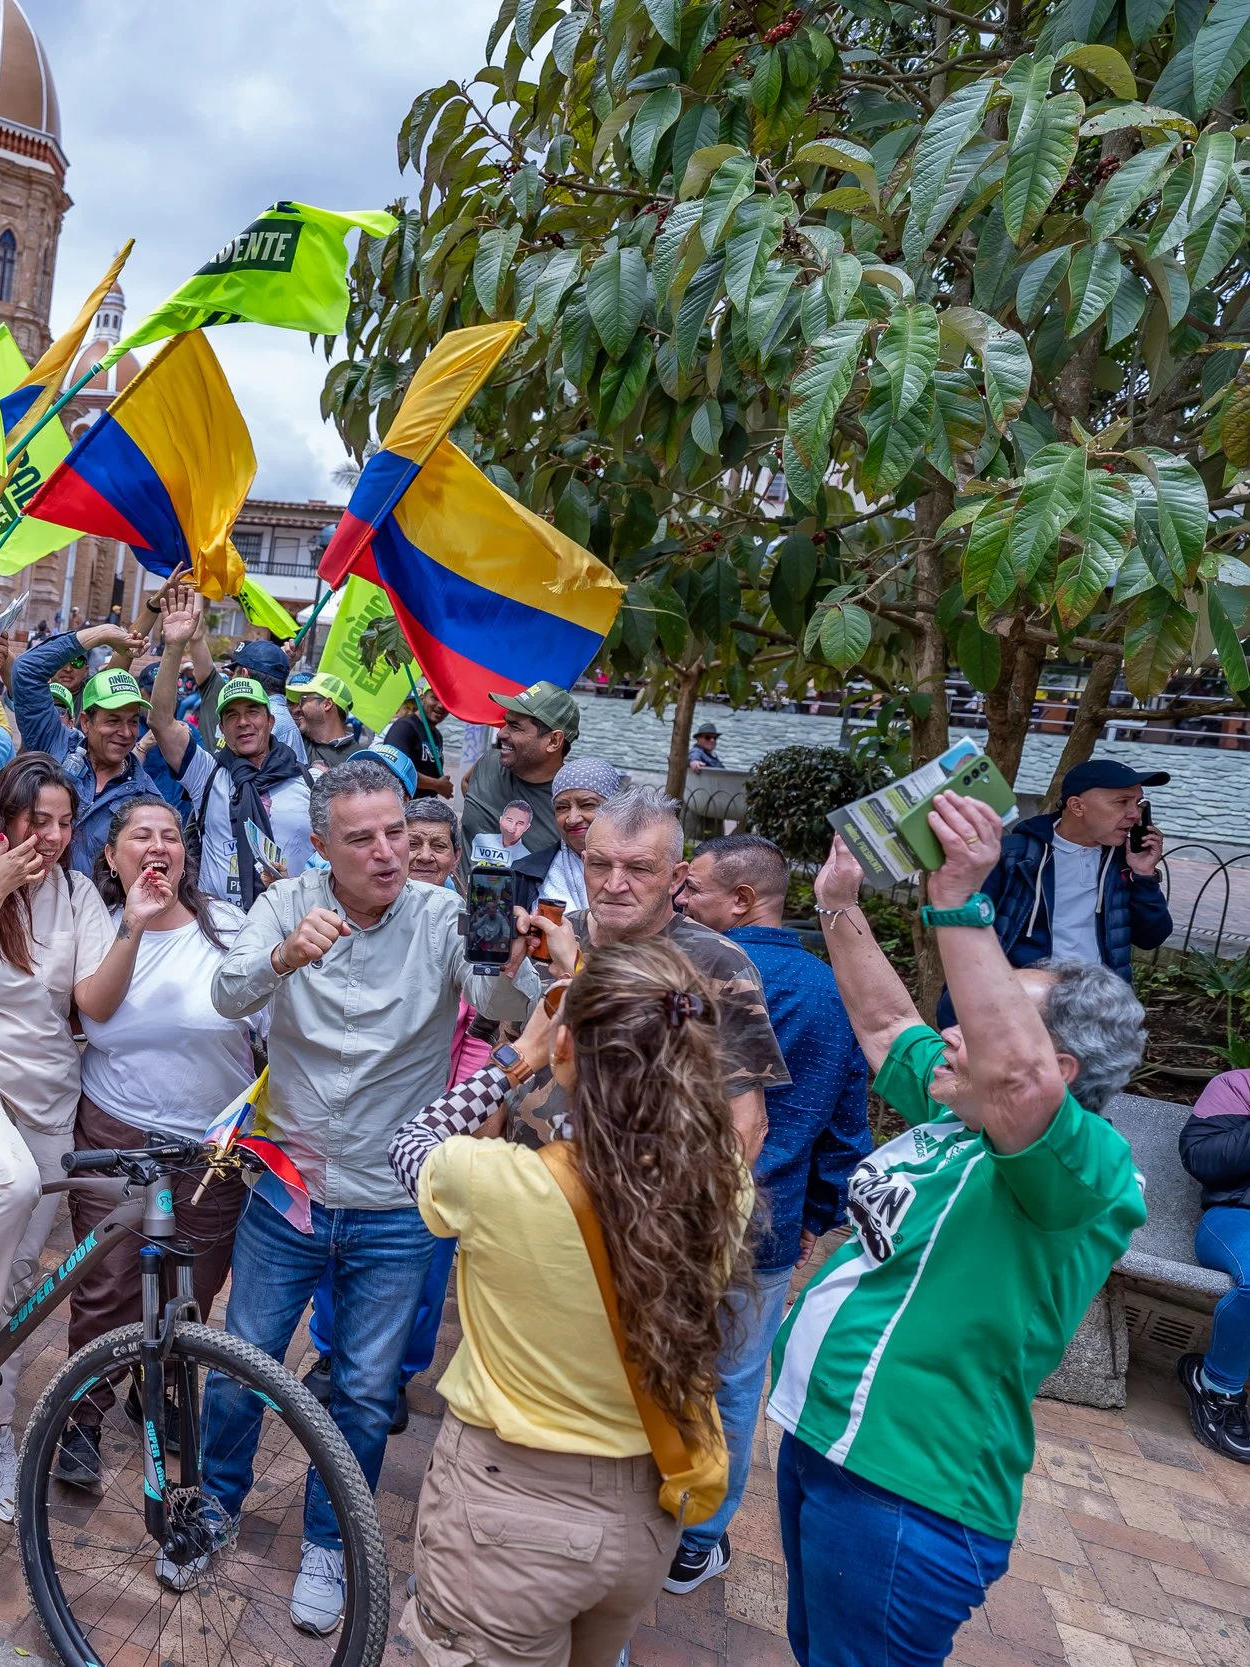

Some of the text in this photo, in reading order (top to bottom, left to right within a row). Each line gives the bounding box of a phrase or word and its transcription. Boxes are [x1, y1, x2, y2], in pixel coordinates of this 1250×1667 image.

[479, 848, 504, 860] VOTA
[913, 1128, 925, 1158] adidas
[10, 1277, 55, 1332] SUPER
[146, 1421, 160, 1458] SUPER
